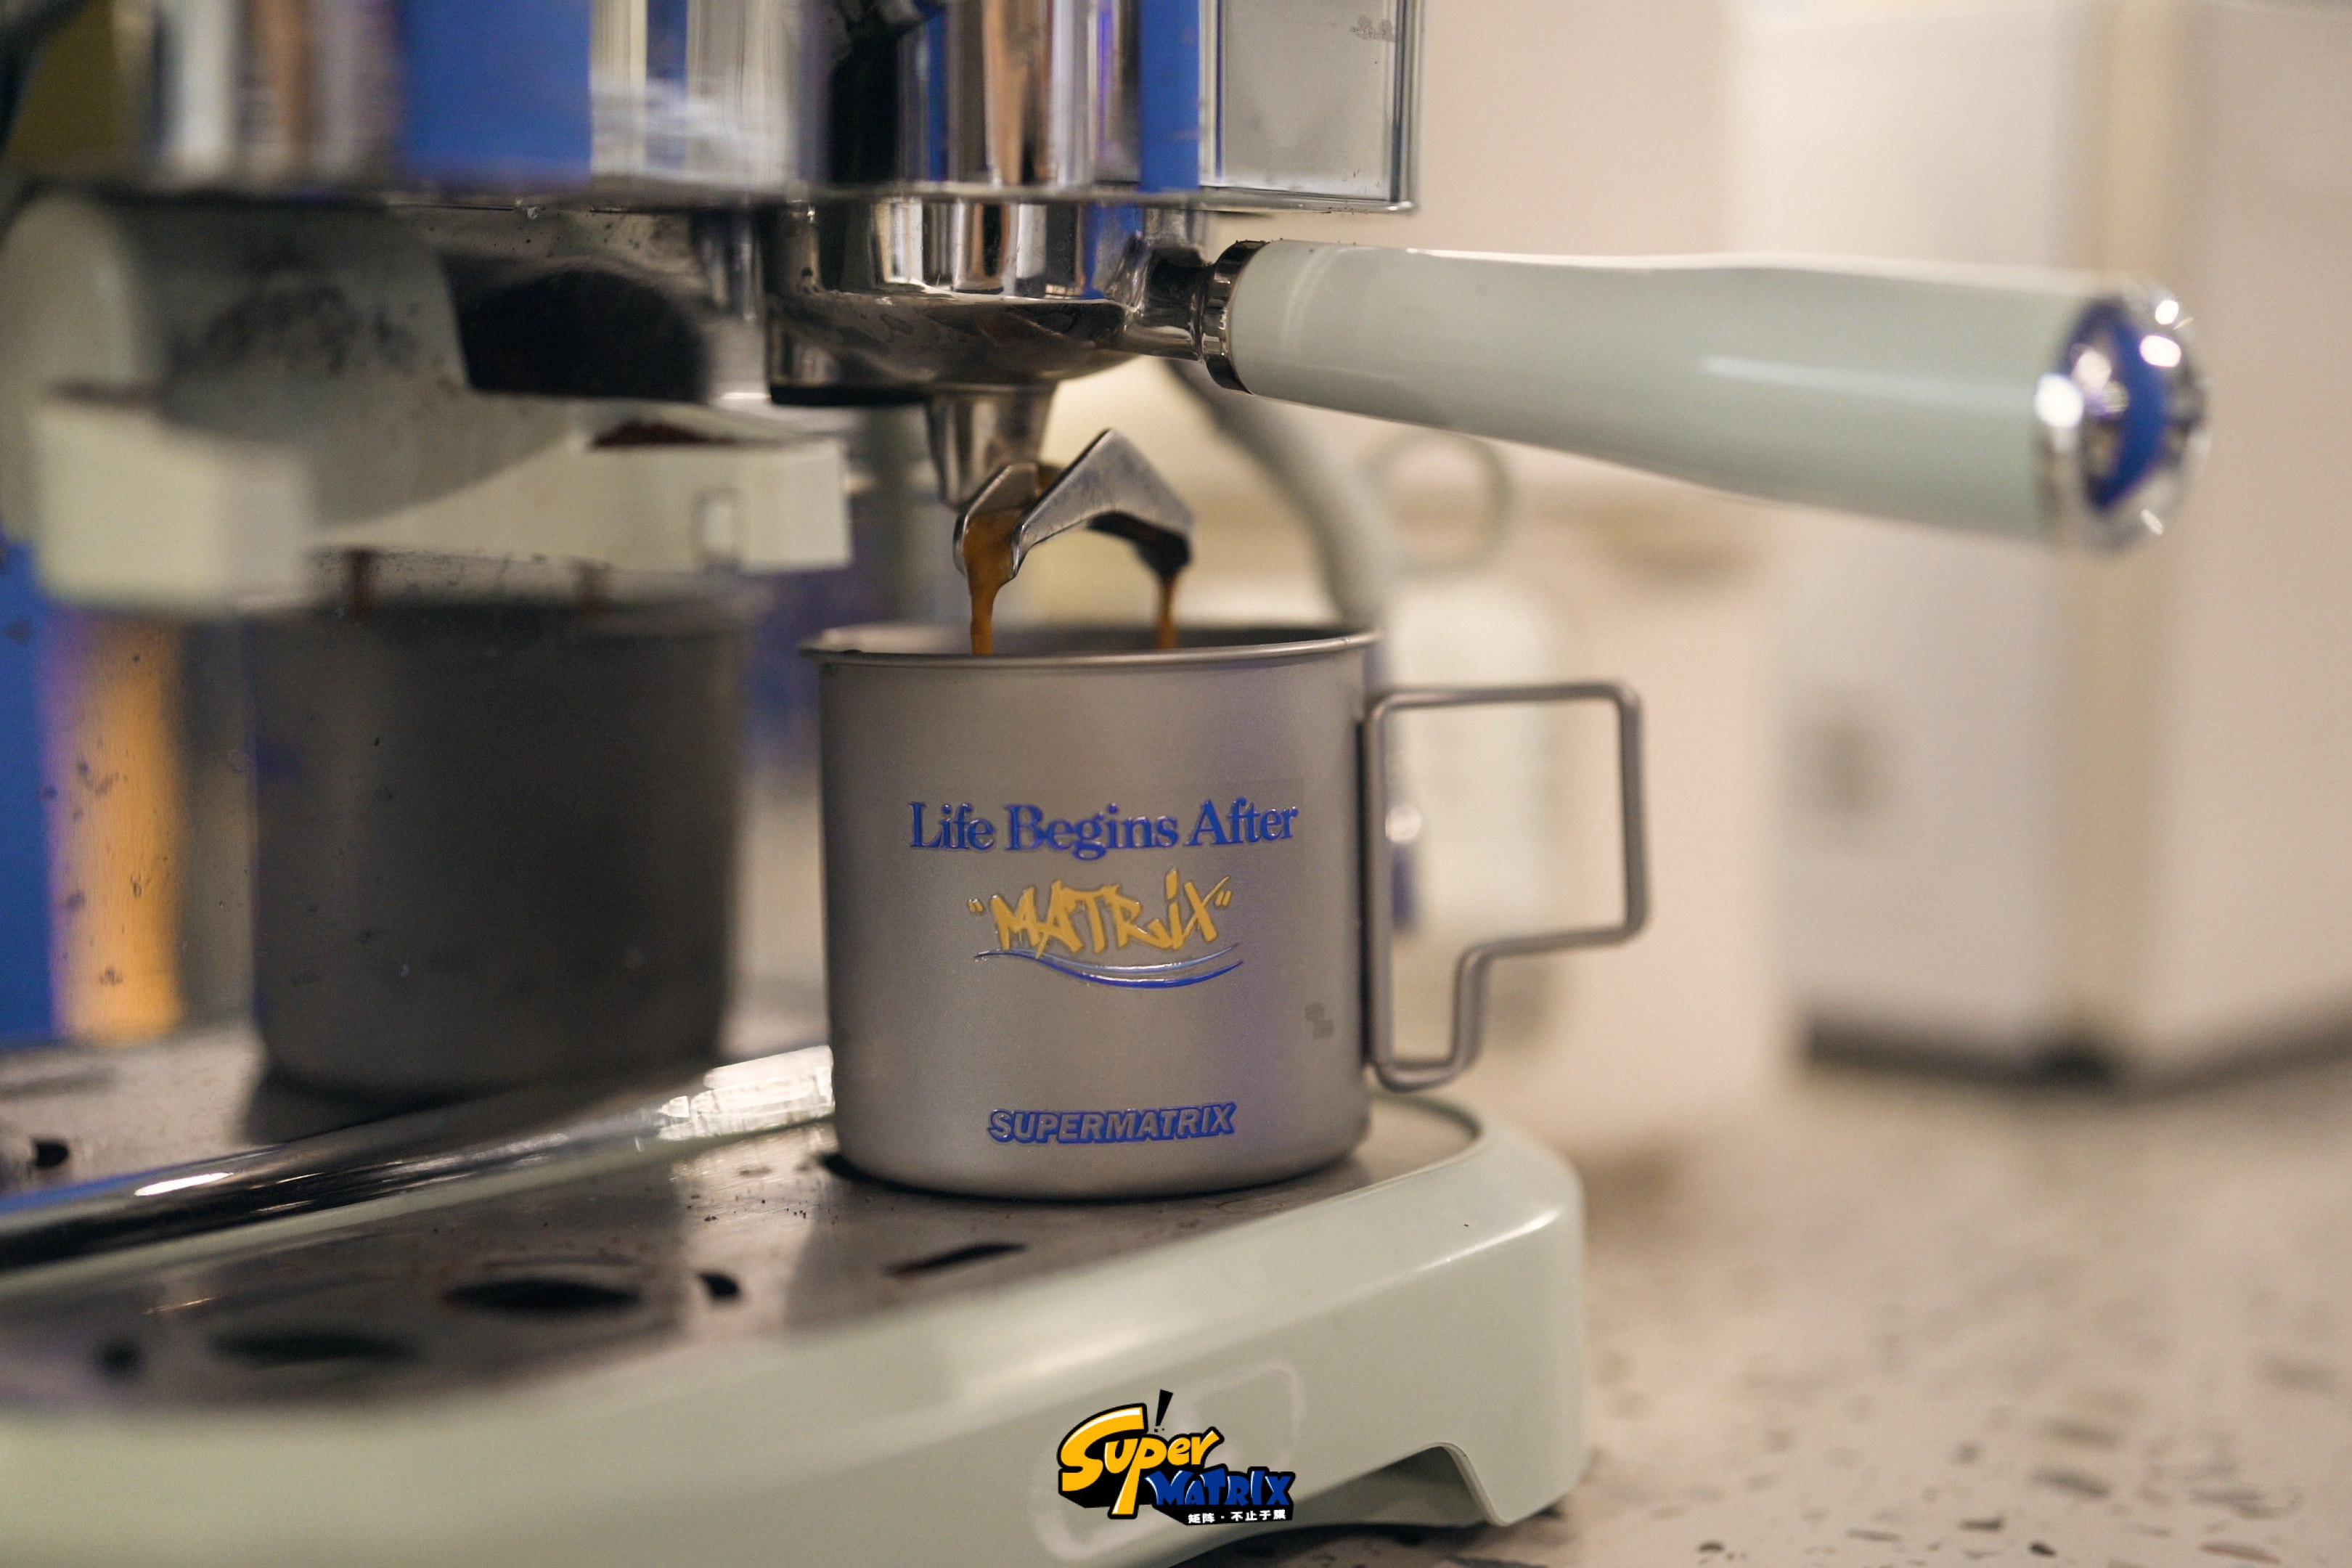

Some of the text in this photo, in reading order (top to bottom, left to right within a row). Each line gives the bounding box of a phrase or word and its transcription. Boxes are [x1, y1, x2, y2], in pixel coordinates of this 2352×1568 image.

[910, 796, 1299, 860] Life Begins After
[987, 1103, 1236, 1143] SUPERMATRIX
